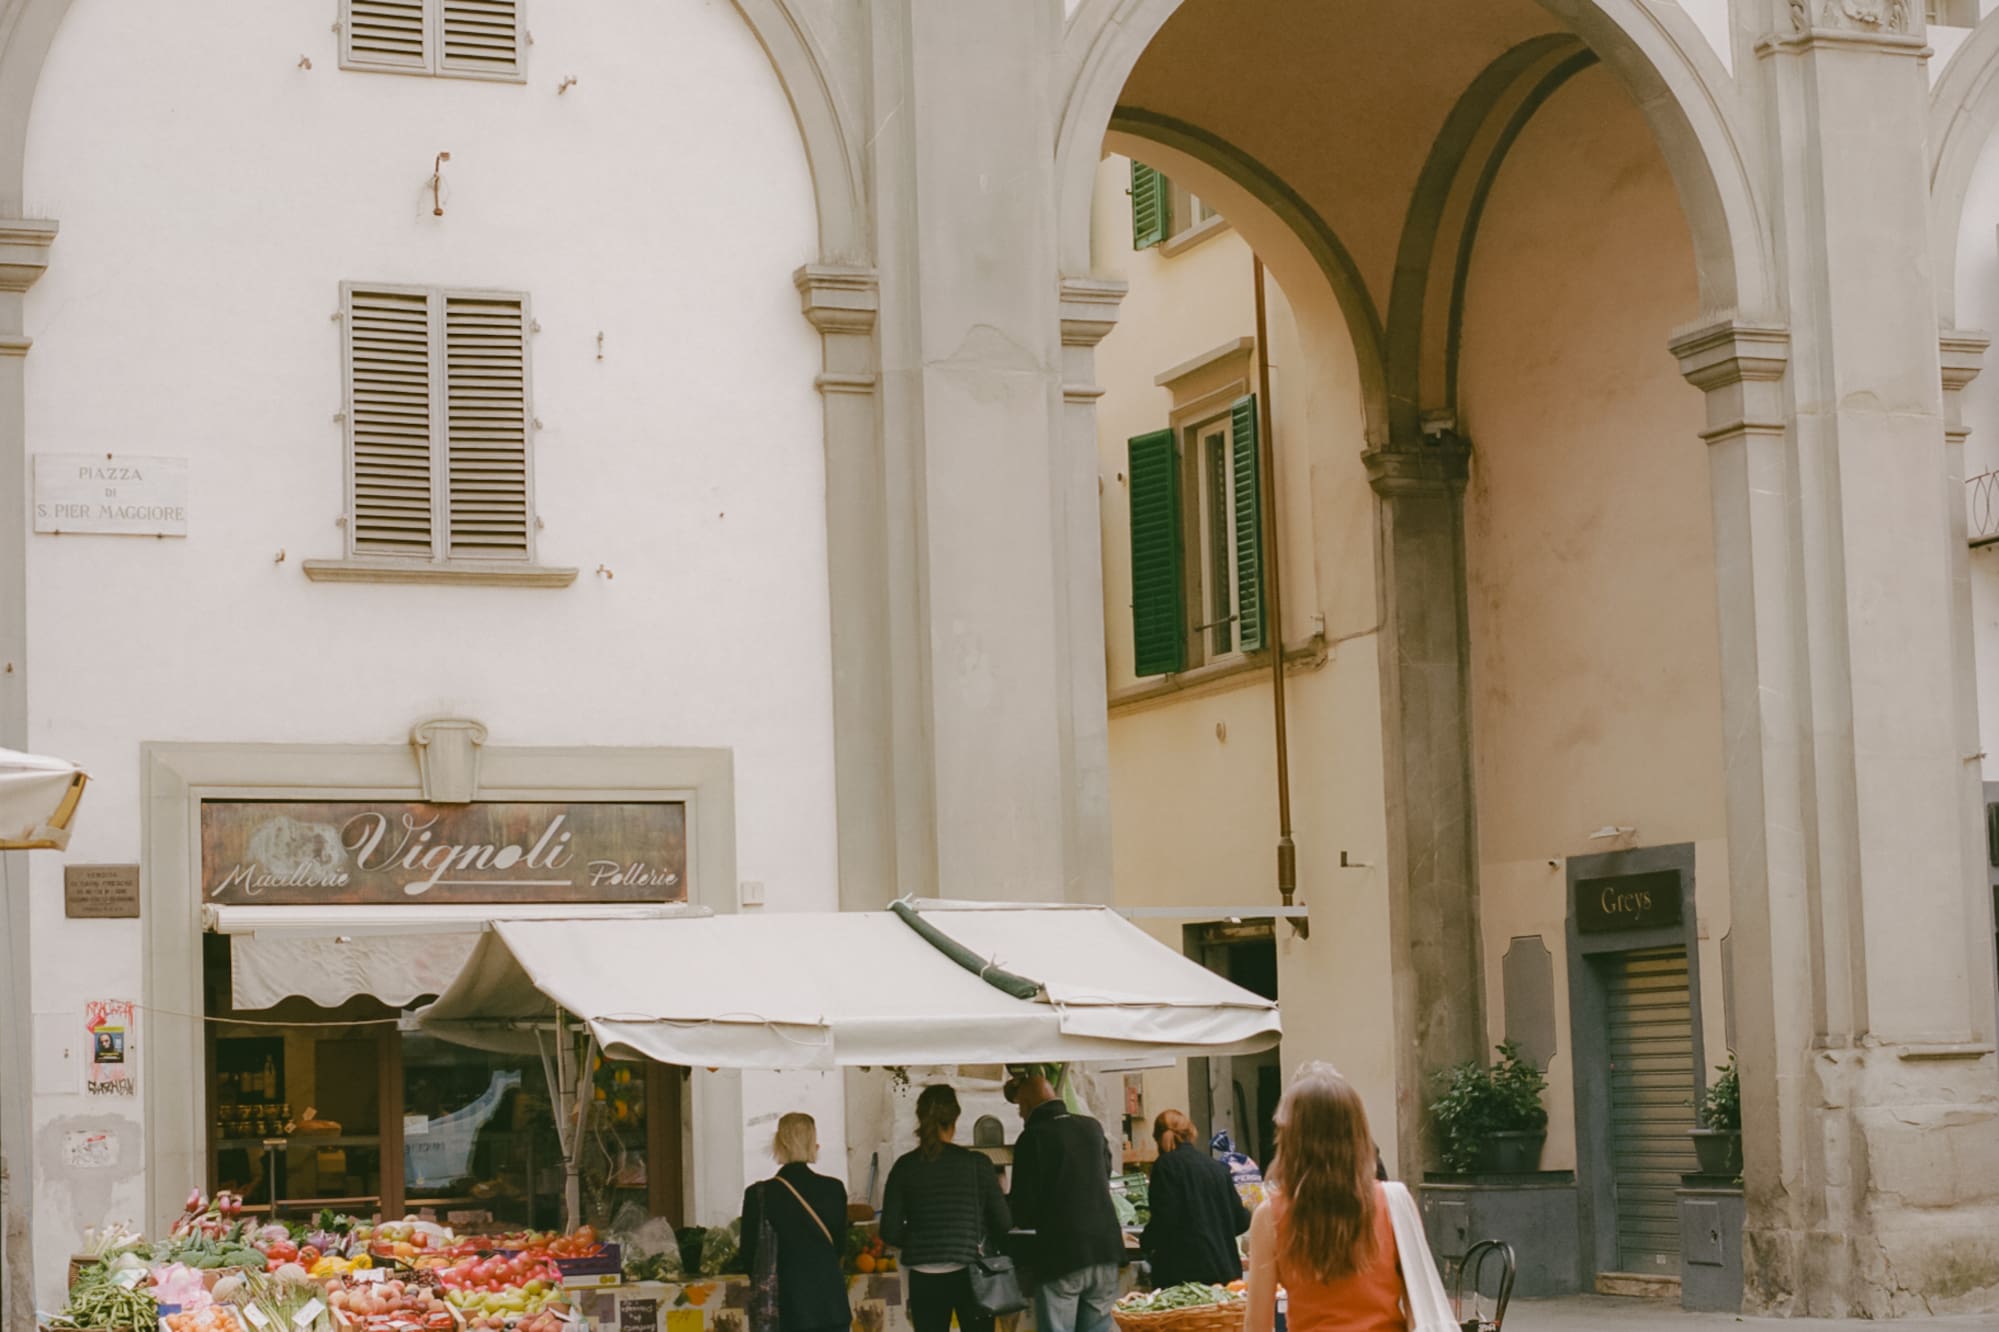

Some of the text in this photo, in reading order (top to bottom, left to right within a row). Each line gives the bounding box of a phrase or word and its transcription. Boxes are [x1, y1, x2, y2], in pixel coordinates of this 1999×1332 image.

[79, 466, 143, 481] PIAZZA
[105, 487, 117, 498] DI
[55, 503, 90, 519] PIER
[99, 504, 184, 521] MAGGIORE
[341, 811, 573, 895] Vignoli
[1601, 886, 1653, 920] Greys
